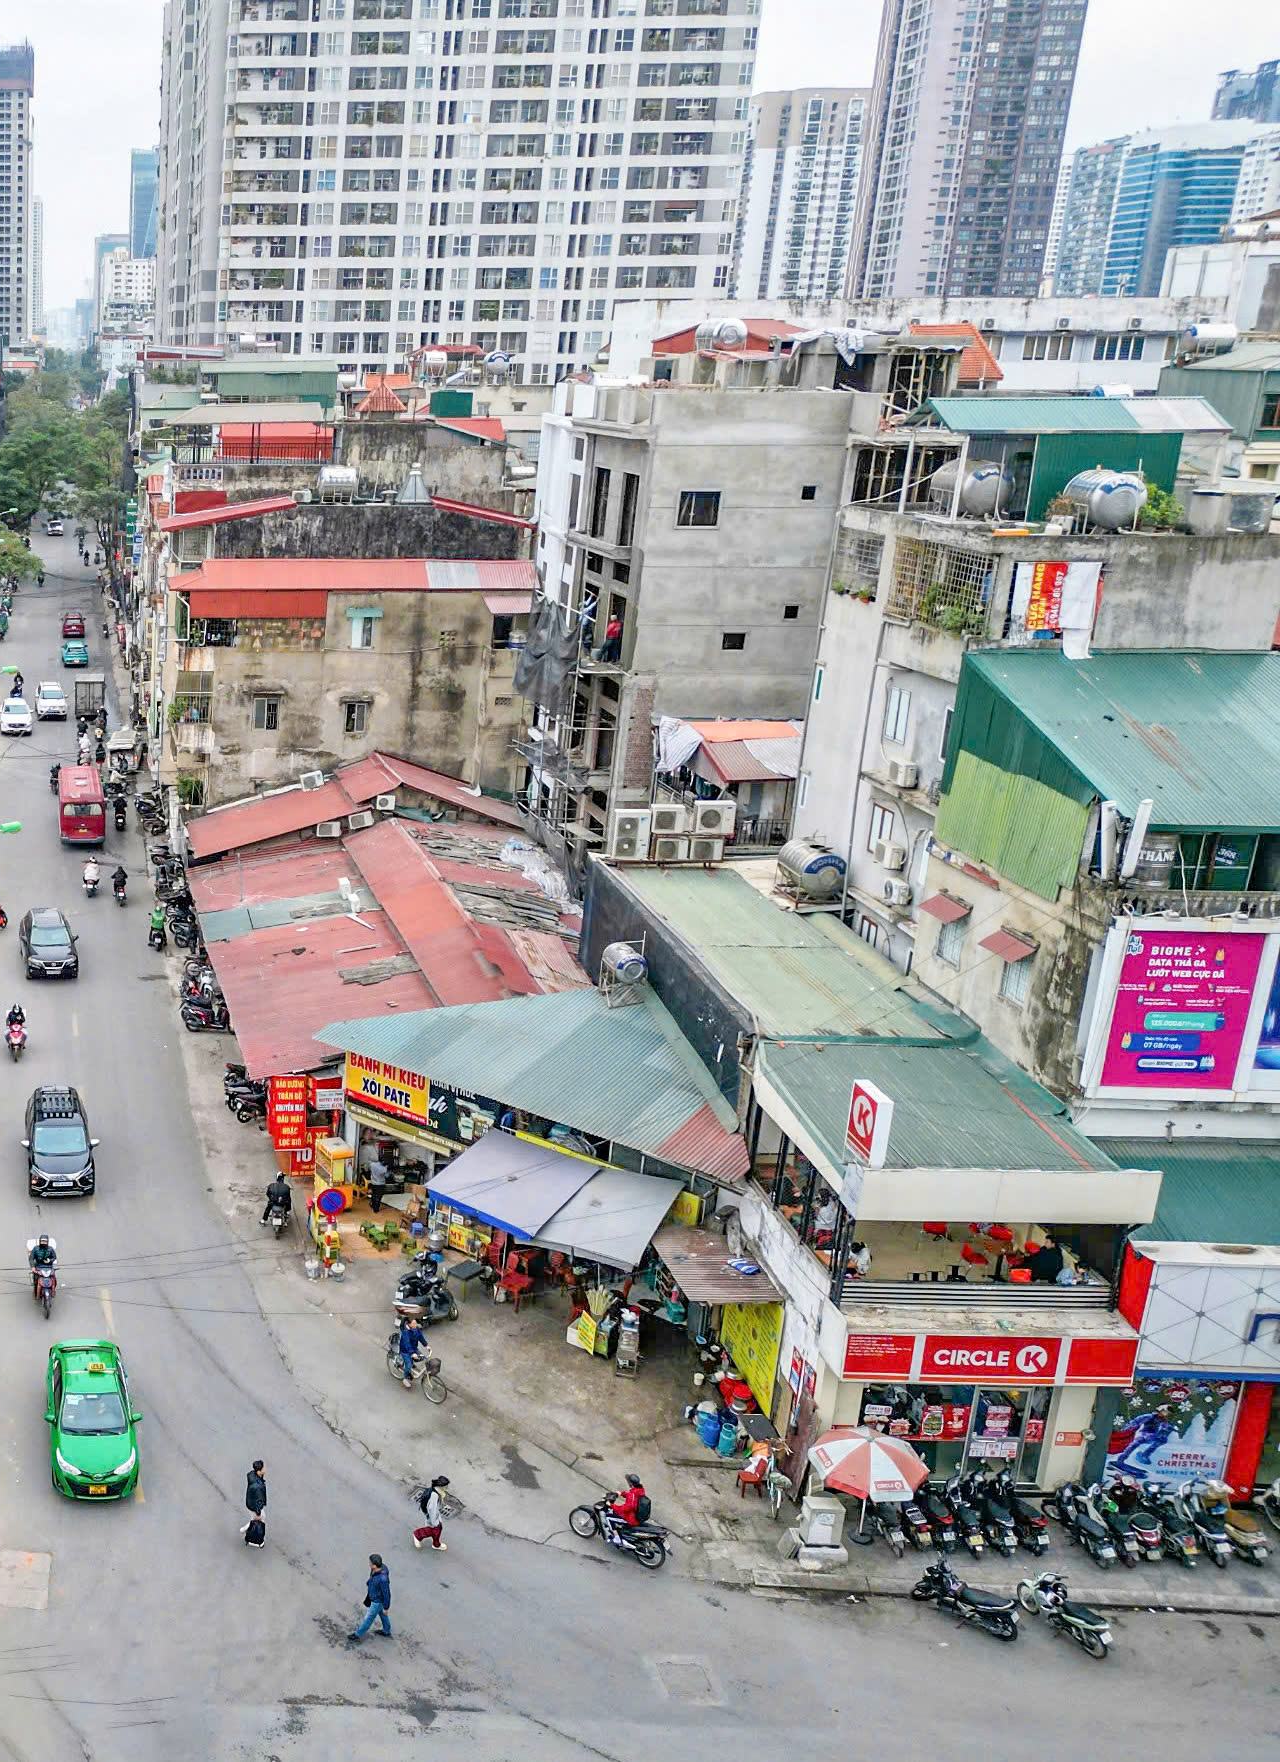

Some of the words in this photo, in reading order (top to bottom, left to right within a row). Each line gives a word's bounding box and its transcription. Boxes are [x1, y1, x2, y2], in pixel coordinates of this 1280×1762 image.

[1151, 946, 1192, 956] BIGME
[1148, 958, 1172, 967] DATA
[1171, 969, 1192, 978] WEB
[384, 1085, 411, 1109] PATE
[933, 1349, 1011, 1367] CIRCLE
[1171, 1453, 1206, 1461] MERRY
[1157, 1459, 1217, 1469] CHRISTMAS
